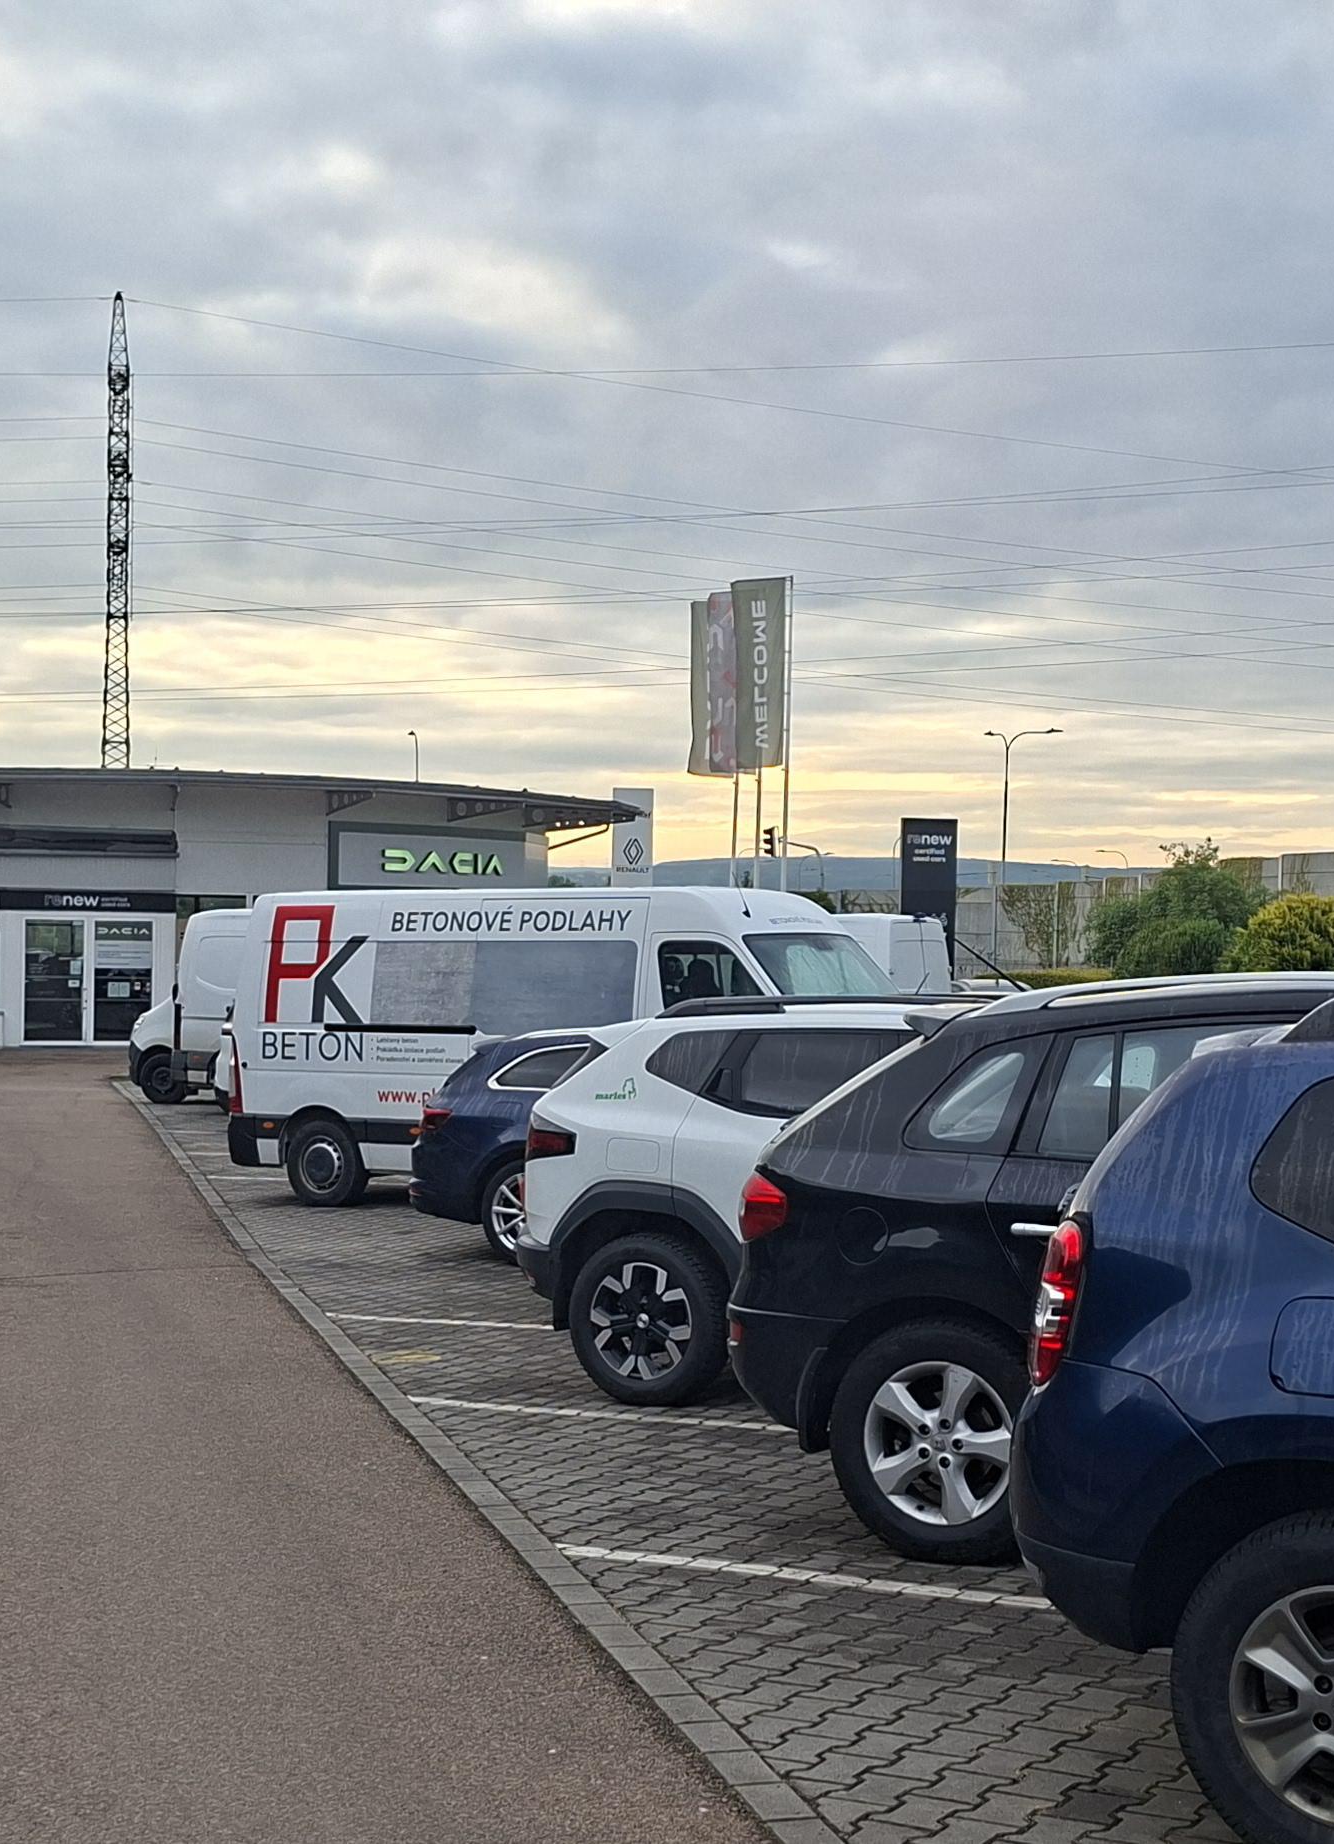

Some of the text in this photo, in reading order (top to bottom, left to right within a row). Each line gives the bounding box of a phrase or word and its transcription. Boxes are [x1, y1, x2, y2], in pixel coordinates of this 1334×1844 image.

[751, 600, 769, 748] WELCOME
[907, 834, 952, 845] renew
[382, 848, 503, 875] DACIA
[44, 894, 99, 907] renew
[97, 927, 149, 935] DACIA
[390, 905, 633, 932] BETONOVÉ PODLAHY
[264, 905, 371, 1024] PK
[262, 1031, 364, 1062] BETON
